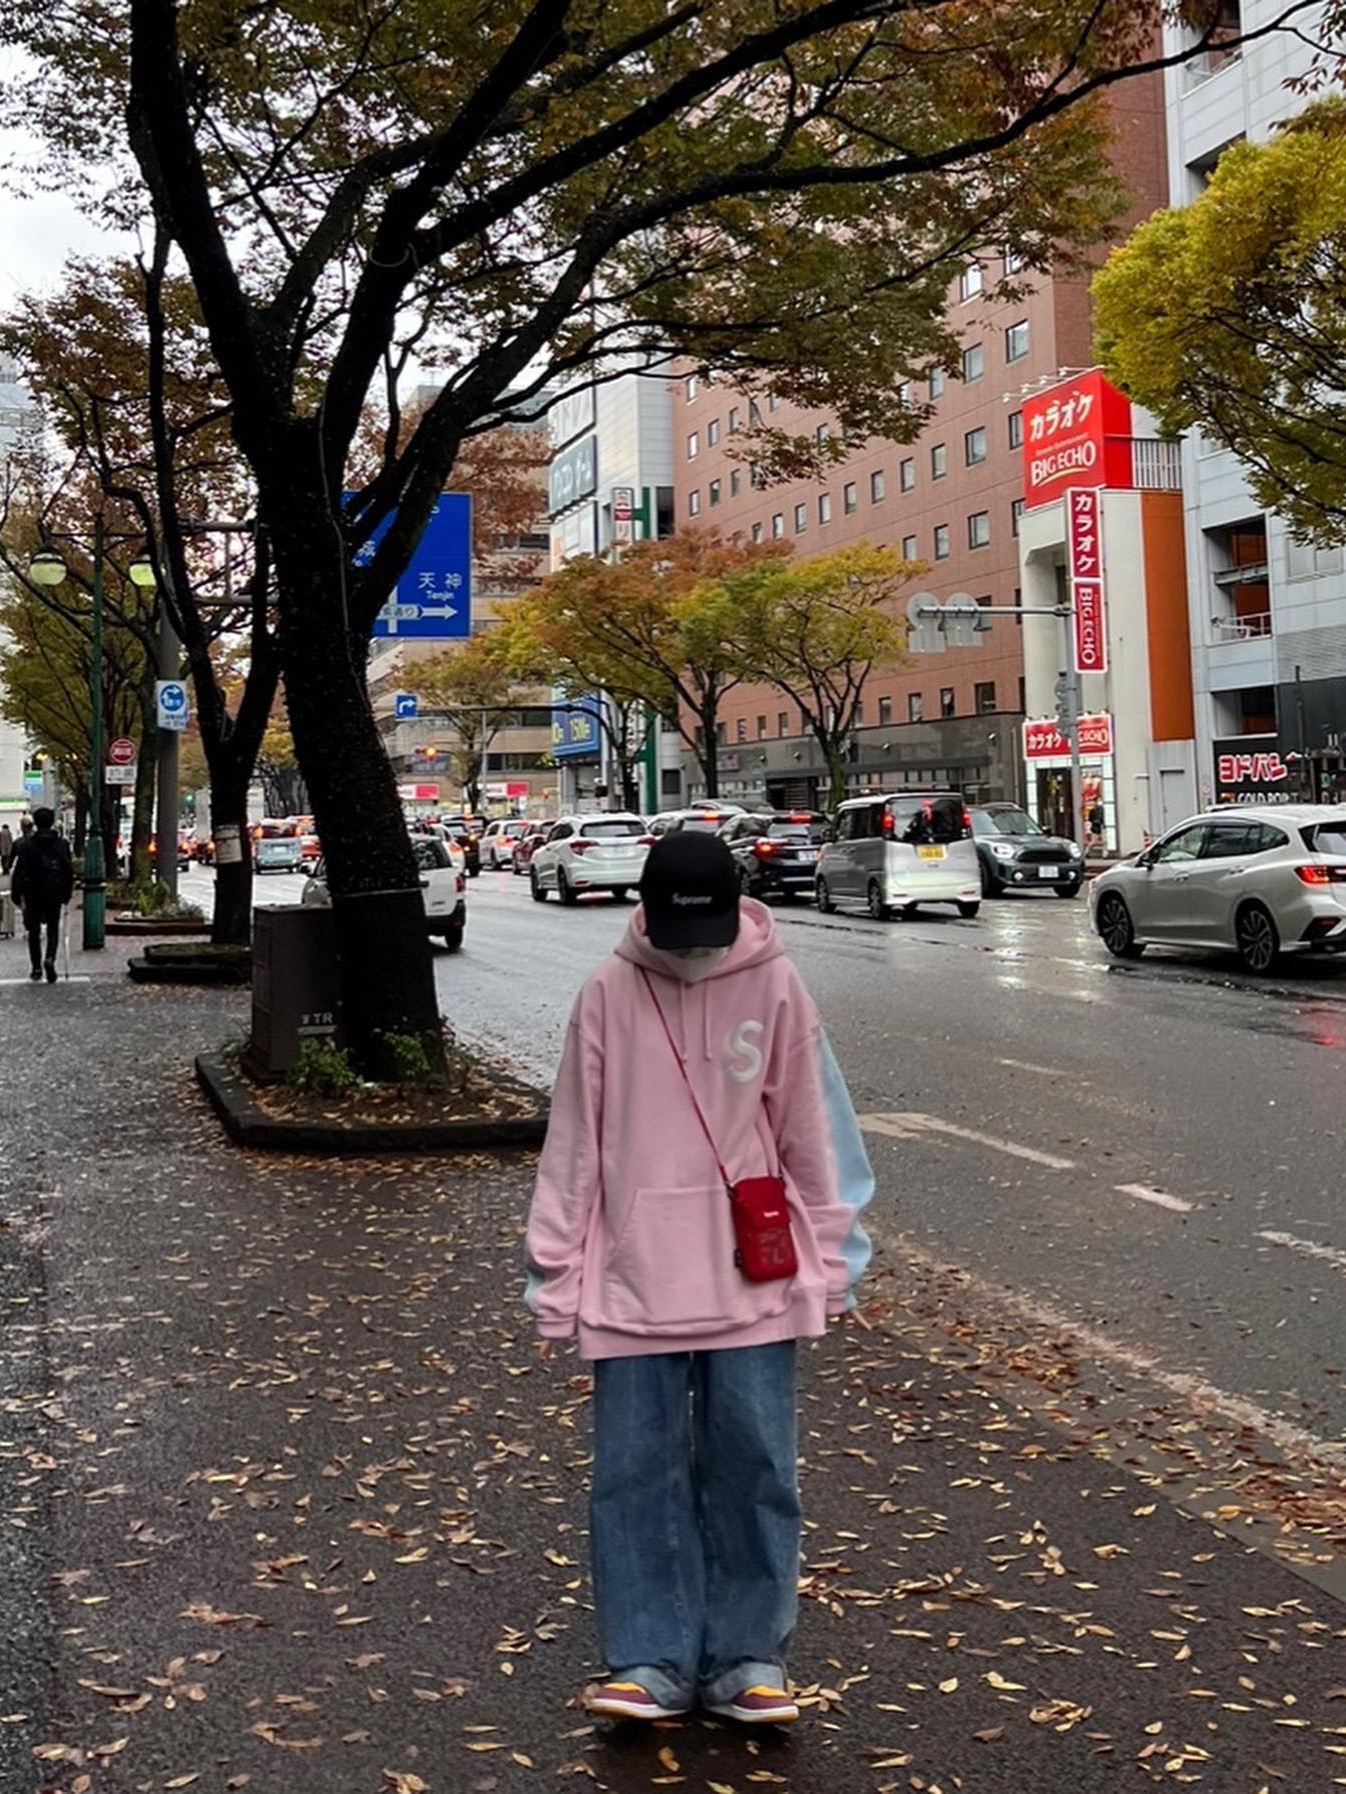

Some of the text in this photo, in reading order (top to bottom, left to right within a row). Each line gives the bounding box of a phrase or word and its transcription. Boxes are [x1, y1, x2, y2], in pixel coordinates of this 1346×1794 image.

[1030, 390, 1093, 442] カラオケ
[1030, 454, 1057, 487] BIG
[1057, 440, 1096, 469] ECHO
[1074, 494, 1096, 572] カラオケ
[418, 572, 463, 589] 天神
[425, 590, 455, 601] Tenjin
[1078, 588, 1096, 664] BIG ECHO
[1027, 728, 1062, 750] カラオケ
[1218, 752, 1302, 783] ヨドバシ
[727, 1020, 764, 1083] S
